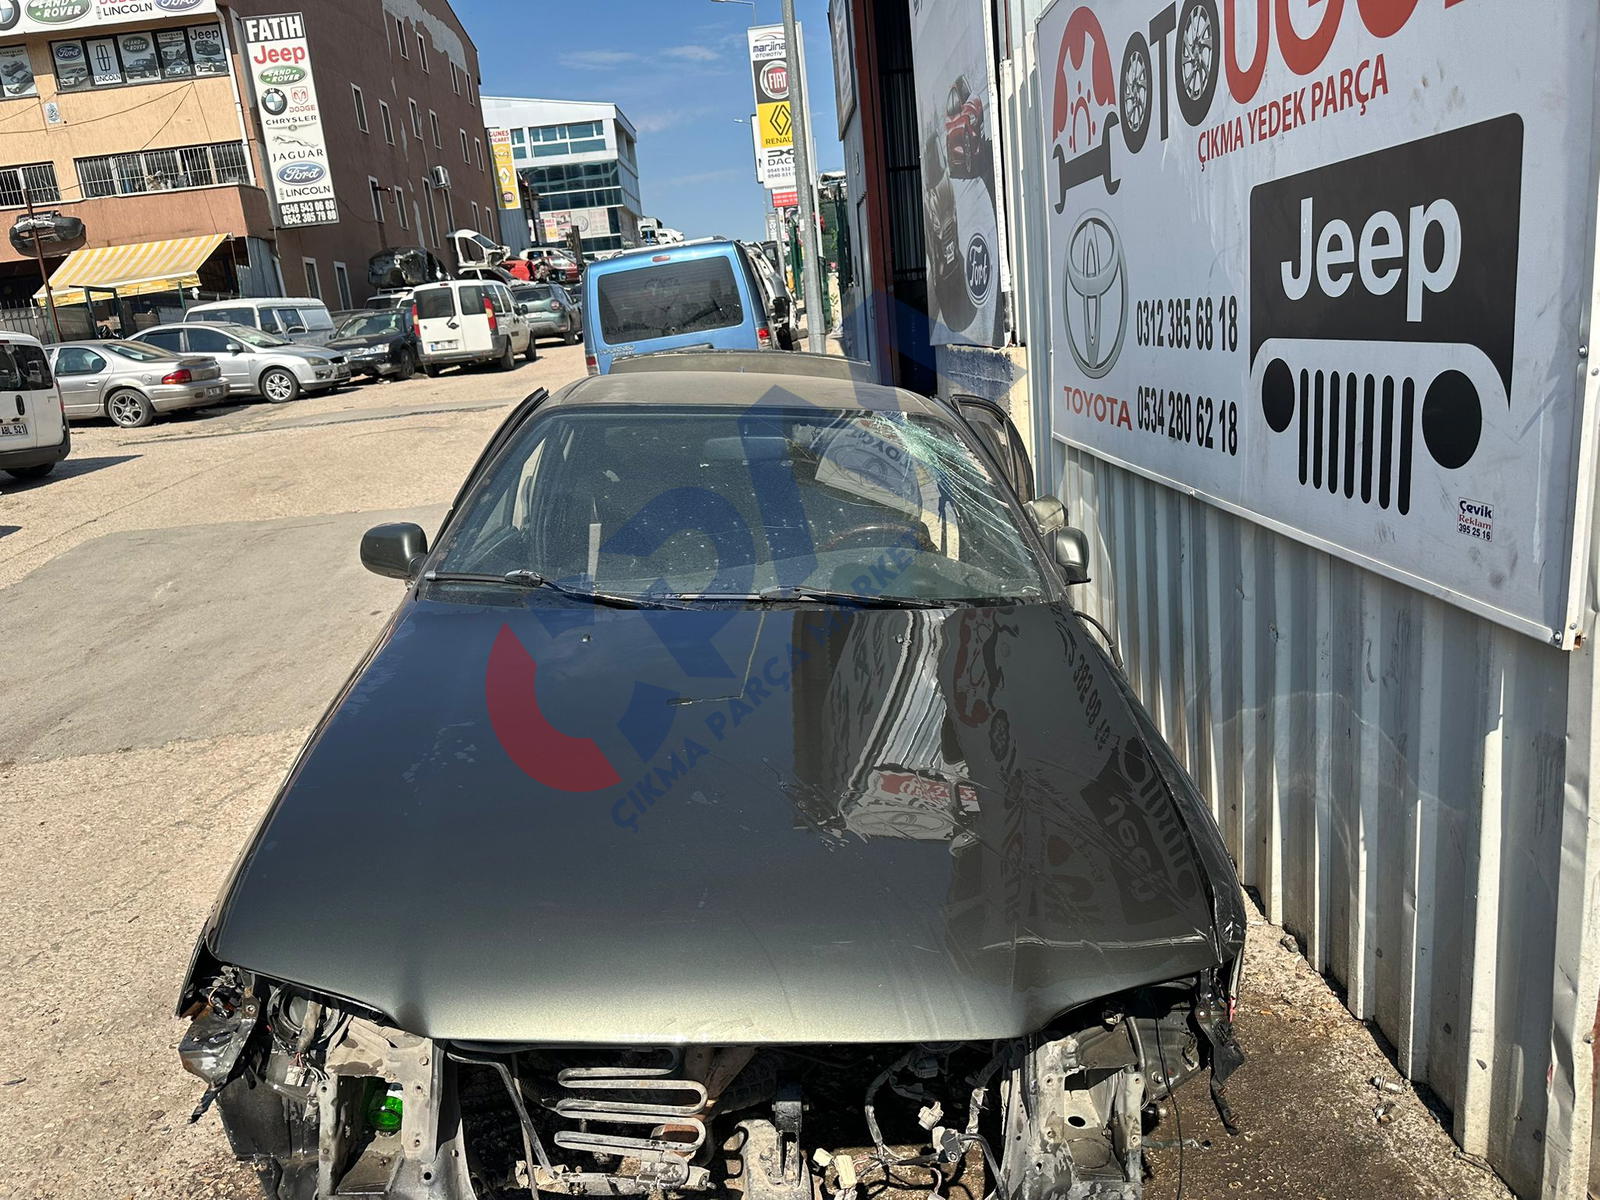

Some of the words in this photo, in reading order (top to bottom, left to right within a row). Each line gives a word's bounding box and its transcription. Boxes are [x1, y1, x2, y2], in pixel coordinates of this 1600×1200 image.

[44, 6, 81, 17] ROVER
[103, 3, 153, 16] LINCOLN
[190, 30, 219, 39] Jeep
[58, 48, 79, 57] Ford
[254, 45, 305, 64] Jeep
[95, 74, 121, 83] LINCOLN
[768, 72, 786, 89] FIAT
[289, 105, 316, 113] DODGE
[1198, 116, 1244, 172] ÇIKMA
[1247, 87, 1306, 144] YEDEK
[1311, 53, 1389, 116] PARÇA
[265, 115, 317, 125] CHRYSLER
[273, 148, 324, 162] JAGUAR
[768, 157, 795, 166] DACI
[284, 166, 321, 181] Ford
[285, 185, 331, 197] LINCOLN
[969, 245, 987, 287] Ford
[1281, 197, 1462, 322] Jeep
[1136, 299, 1164, 347] 0312
[1168, 298, 1191, 350] 385
[1195, 297, 1213, 351] 68
[1219, 295, 1238, 352] 18
[1063, 386, 1133, 431] TOYOTA
[1137, 385, 1165, 435] 0534
[1168, 390, 1192, 443] 280
[1196, 395, 1214, 449] 62
[1219, 399, 1238, 457] 18
[1459, 500, 1493, 519] Çevik
[1458, 514, 1492, 530] Reklam
[1458, 523, 1470, 535] 395
[1472, 526, 1481, 538] 25
[1482, 530, 1491, 541] 16
